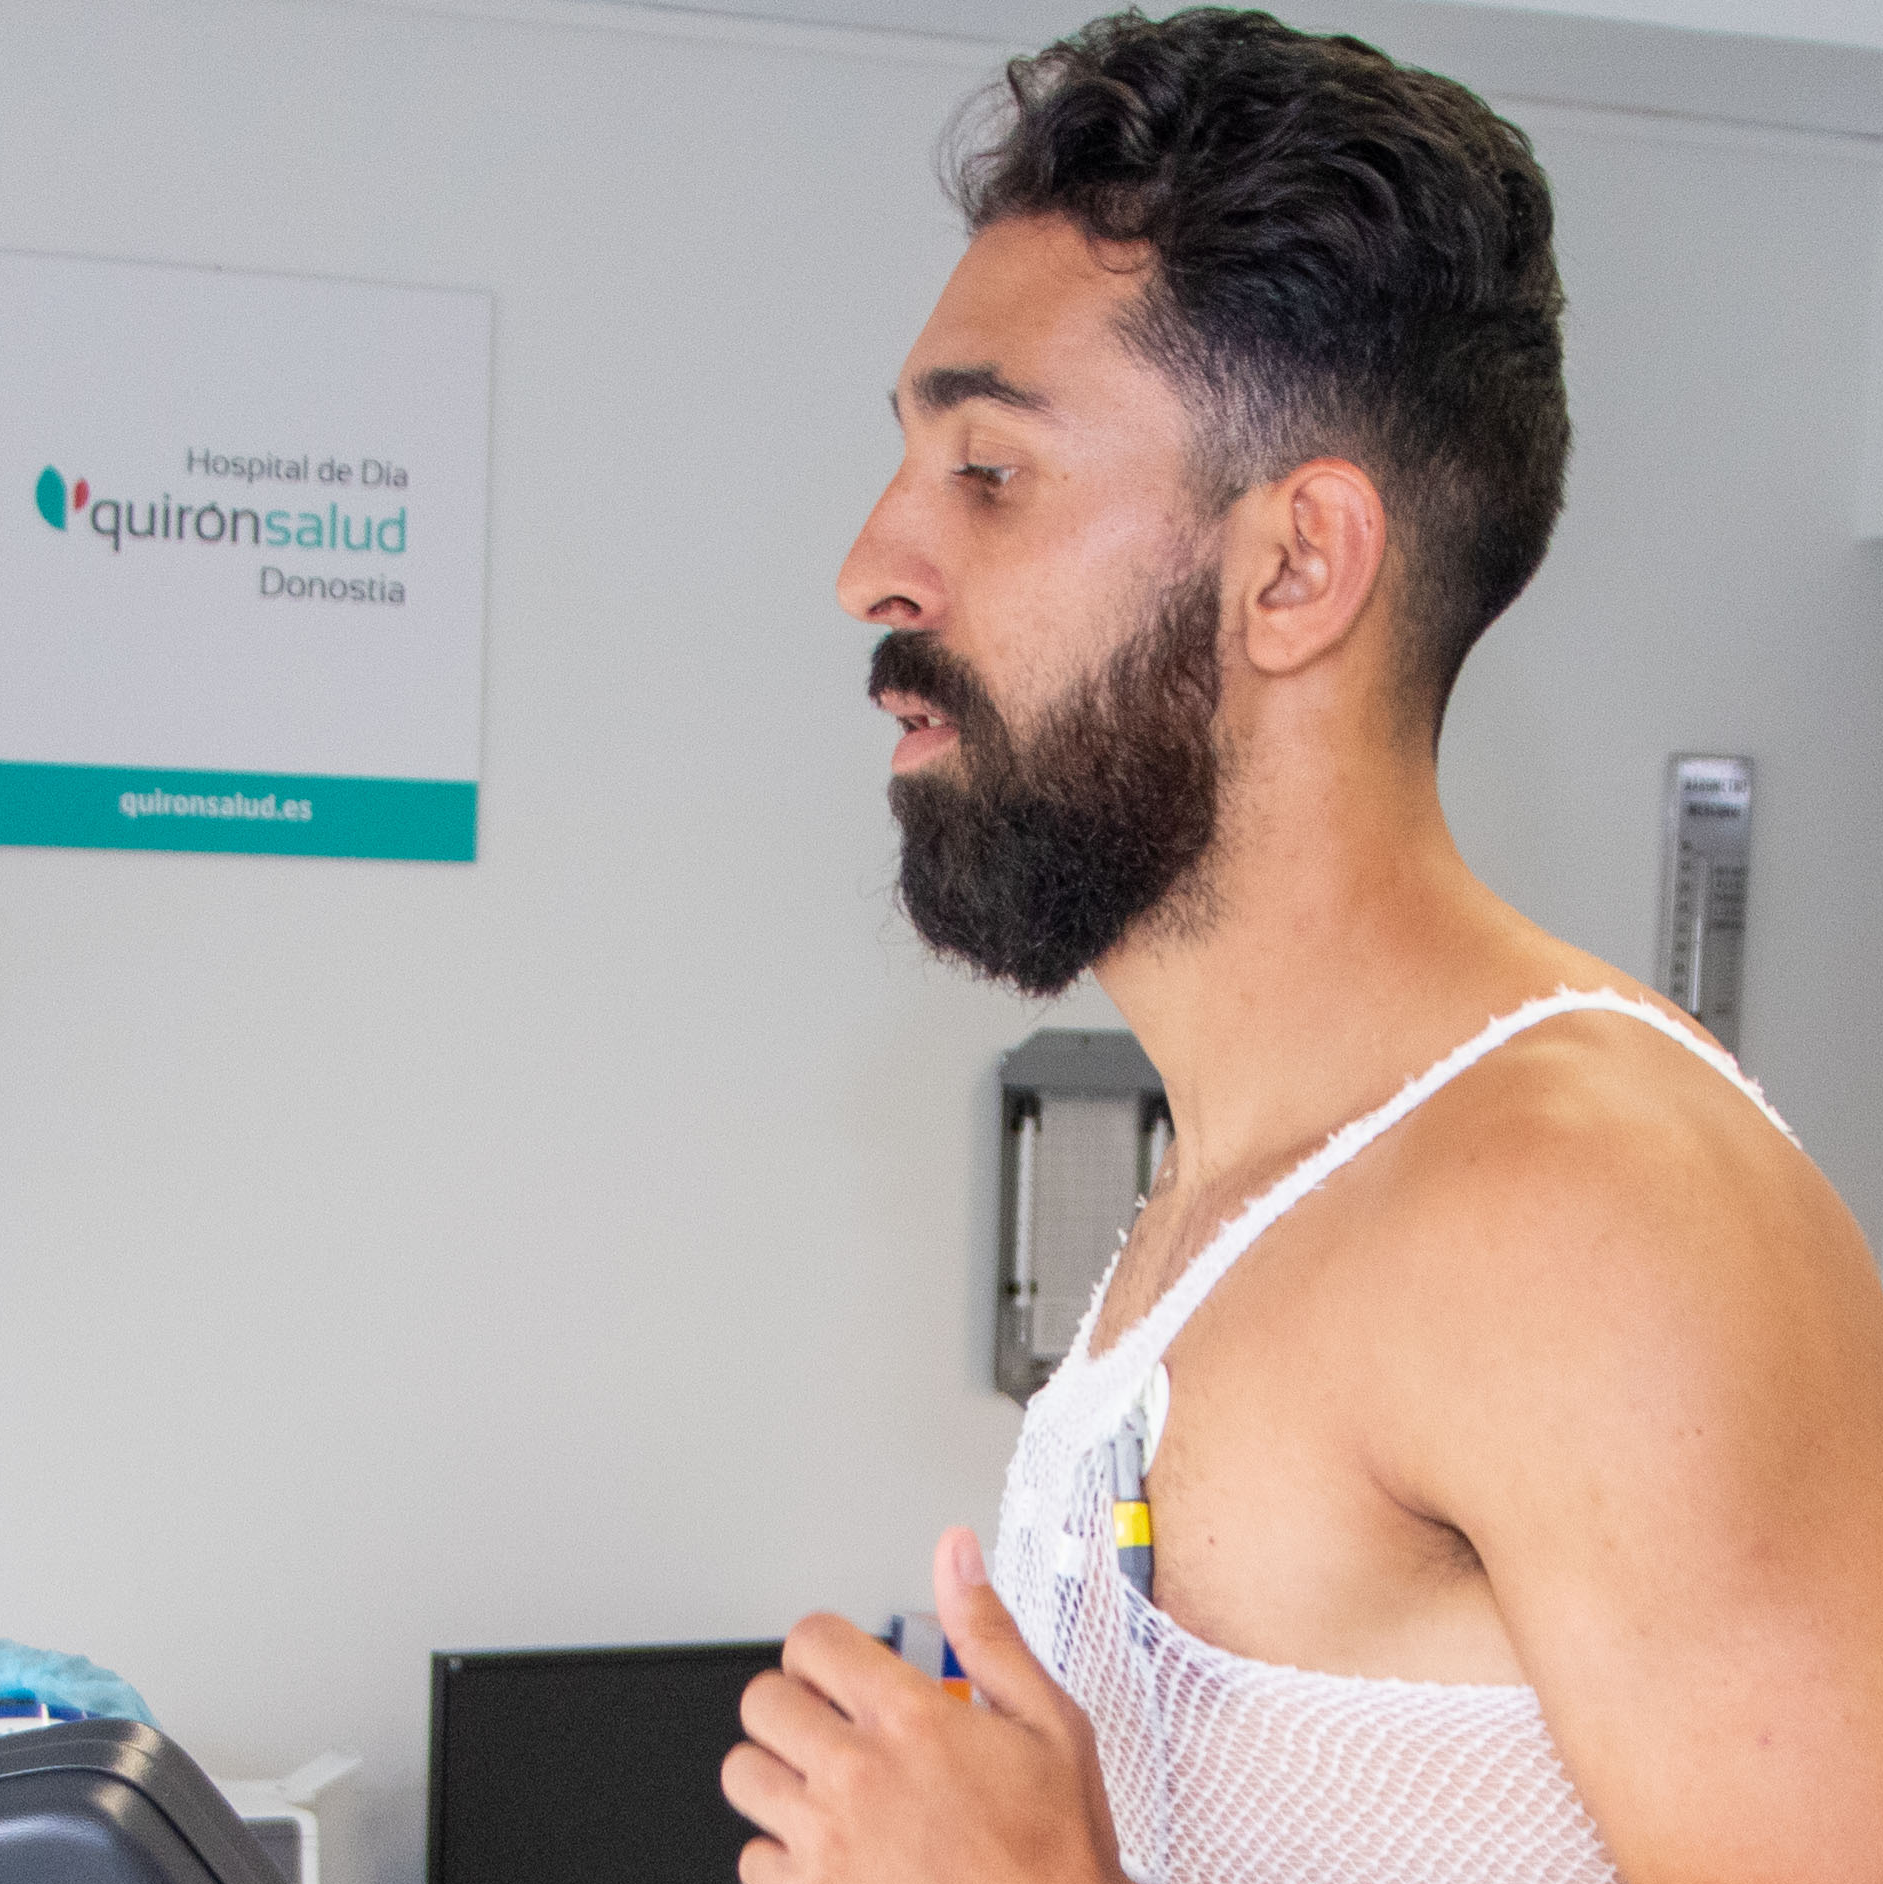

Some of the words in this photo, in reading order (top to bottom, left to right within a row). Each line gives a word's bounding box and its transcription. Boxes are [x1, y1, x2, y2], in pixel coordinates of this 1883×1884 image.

[186, 447, 309, 486] Hospital
[317, 455, 353, 486] de
[361, 458, 409, 490] Día
[89, 494, 408, 554] quirónsalud
[259, 565, 406, 606] Donostia
[119, 789, 313, 822] quironsalud.es
